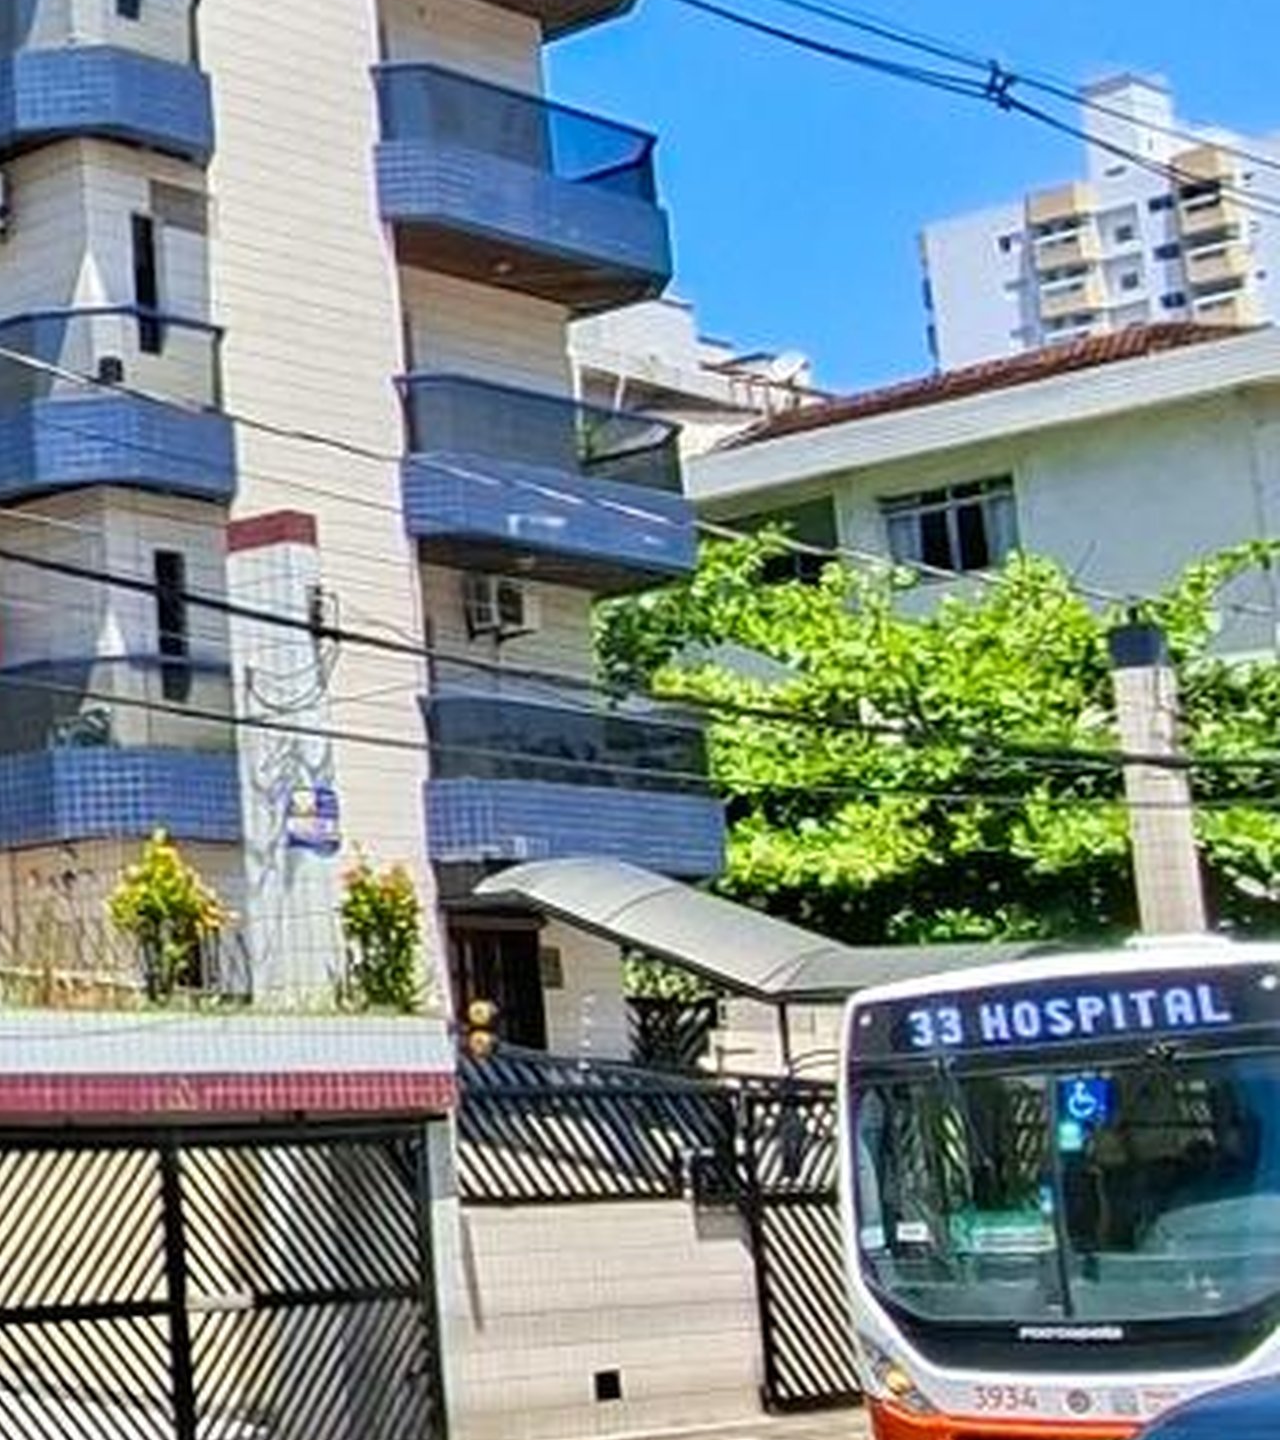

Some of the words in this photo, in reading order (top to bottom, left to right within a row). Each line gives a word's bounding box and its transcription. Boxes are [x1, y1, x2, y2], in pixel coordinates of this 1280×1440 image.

[907, 1008, 963, 1047] 33
[980, 984, 1232, 1041] HOSPITAL
[974, 1383, 1038, 1411] 3934
